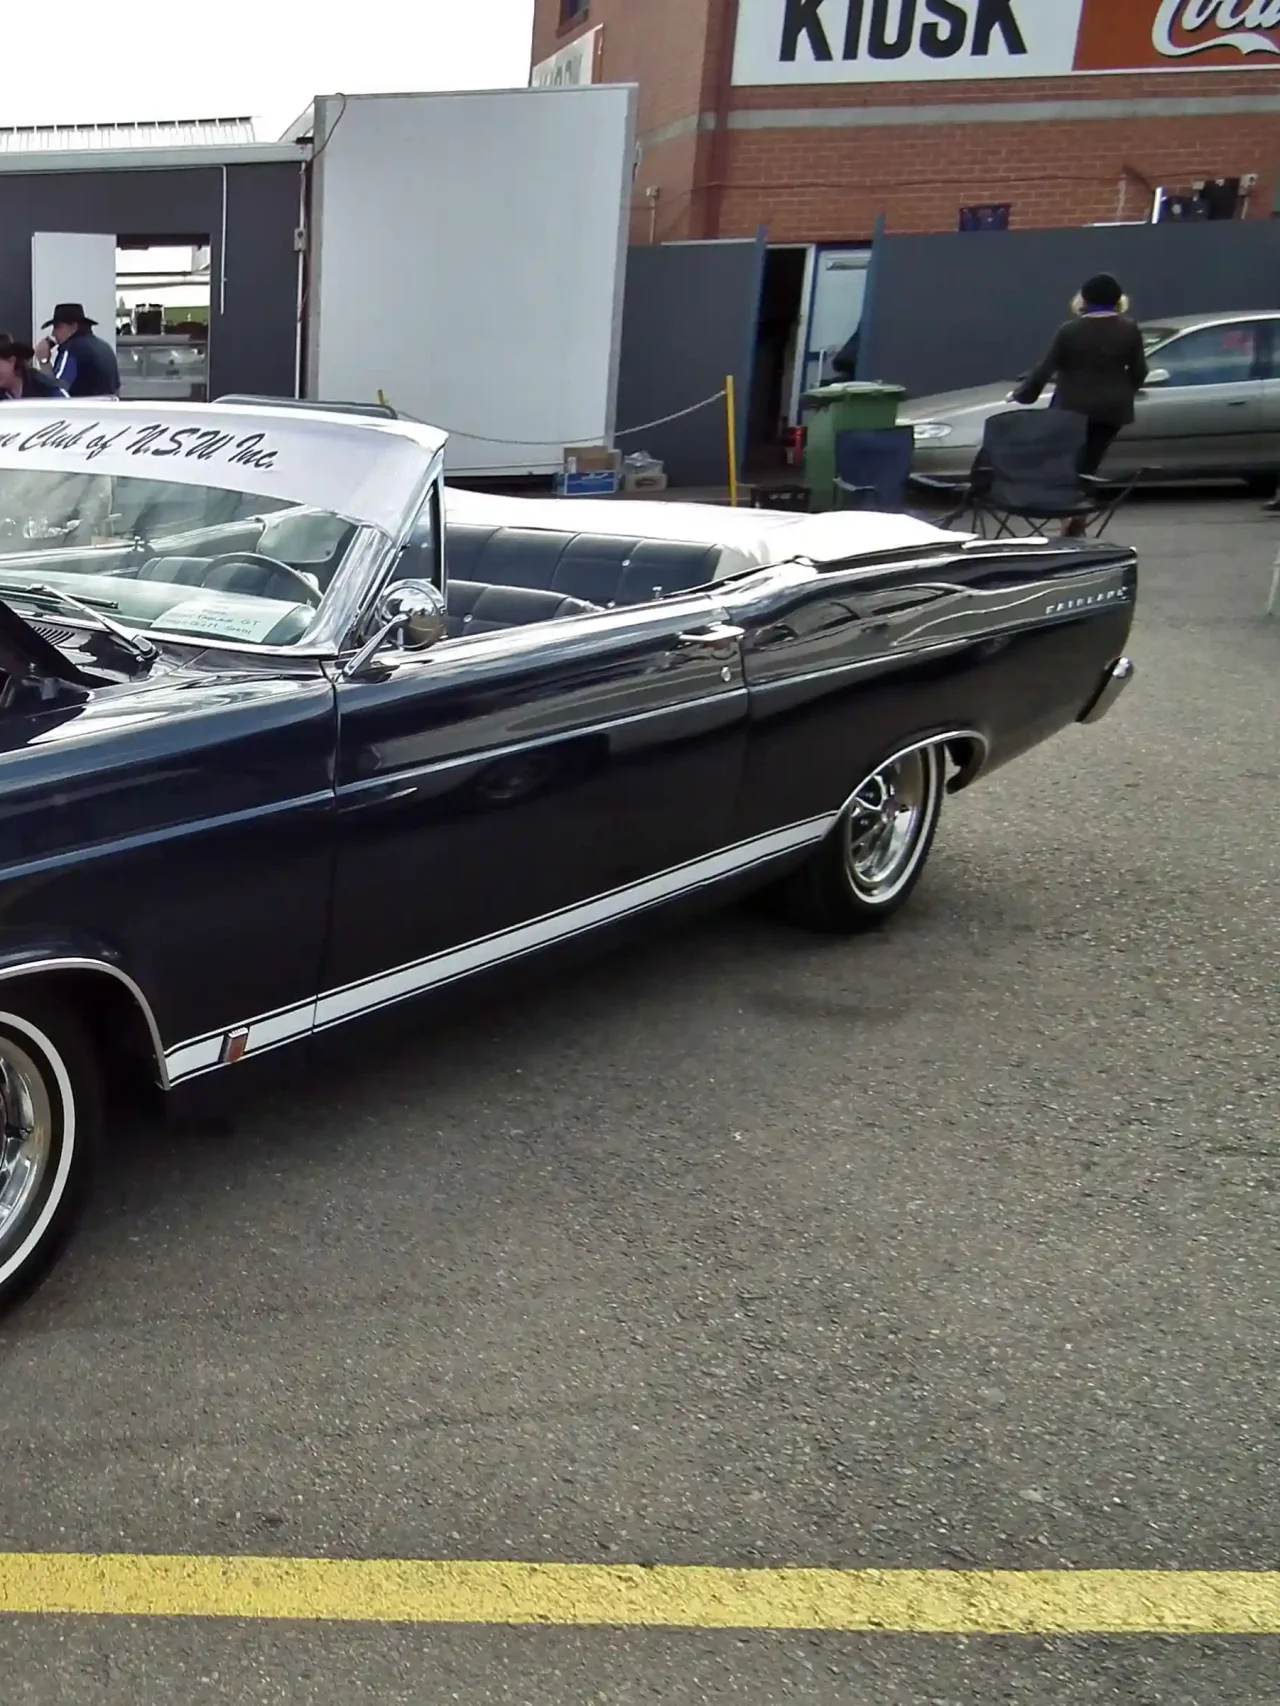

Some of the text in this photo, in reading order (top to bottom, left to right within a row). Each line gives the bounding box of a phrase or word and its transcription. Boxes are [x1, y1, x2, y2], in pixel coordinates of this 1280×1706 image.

[779, 0, 1028, 62] KIOSK
[18, 420, 81, 452] Club
[86, 422, 132, 461] of
[125, 424, 222, 461] N.S.W.
[226, 433, 275, 469] Inc.
